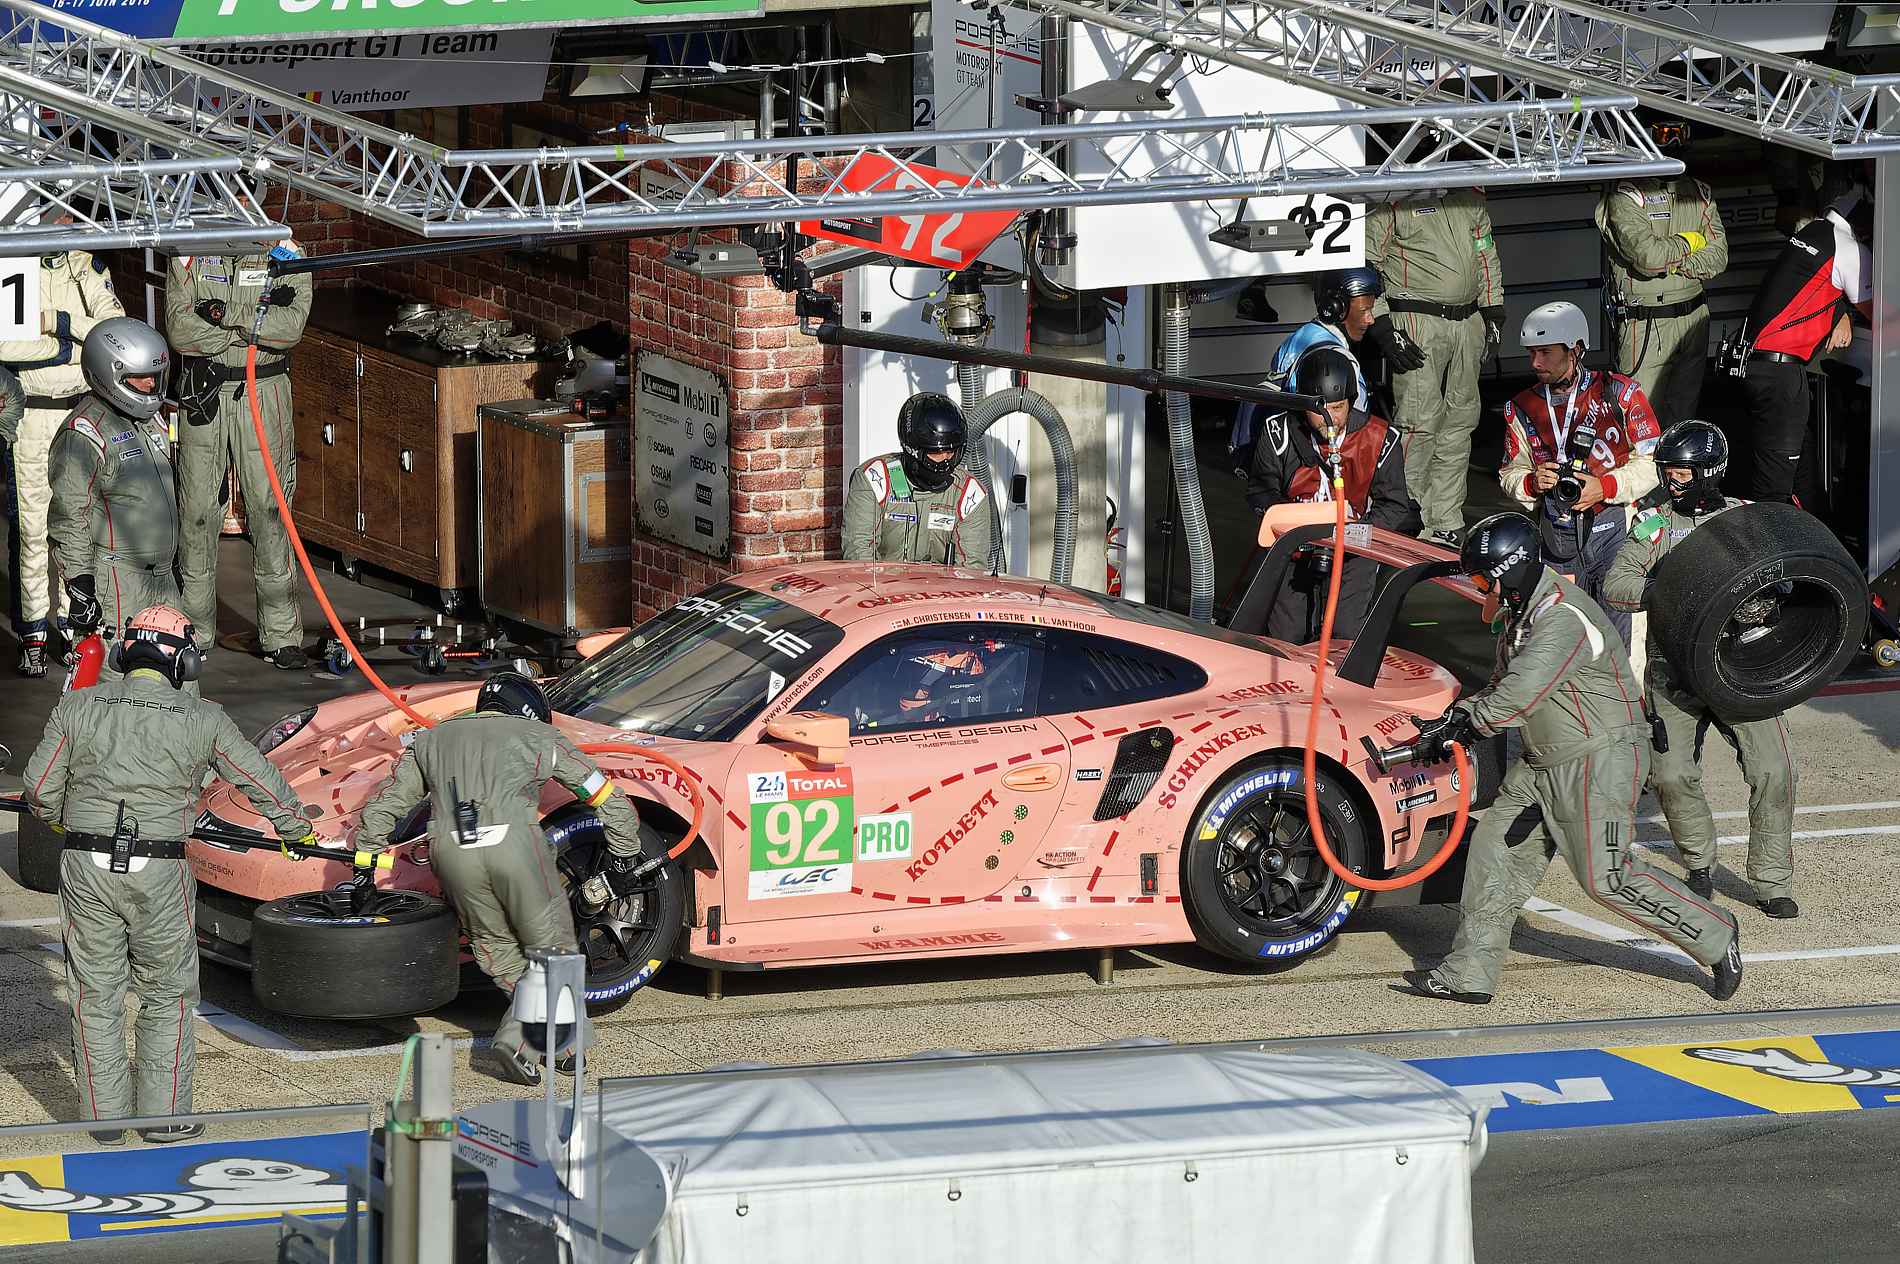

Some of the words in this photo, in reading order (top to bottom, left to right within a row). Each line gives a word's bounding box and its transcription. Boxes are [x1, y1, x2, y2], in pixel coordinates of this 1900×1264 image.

[956, 51, 1003, 76] MOTORSPRT
[331, 88, 411, 105] Vanthoor
[683, 386, 710, 415] Mobil
[650, 464, 672, 483] OSRAM
[689, 455, 717, 476] RECARO
[1703, 462, 1728, 478] uve
[1489, 545, 1529, 579] uvex
[914, 611, 971, 624] CHRISTENSEN
[998, 612, 1025, 622] ESTRE
[1051, 618, 1097, 633] VANTHOOR
[93, 696, 186, 715] PORSCHE
[761, 665, 826, 726] www.porsche.com
[850, 731, 951, 748] PORSCHE
[958, 723, 1038, 737] DESIGN
[915, 738, 979, 749] TIMEPIECES
[1158, 722, 1268, 810] SCHINKEN
[790, 777, 848, 792] TOTAL
[1219, 771, 1292, 814] MICHELIN
[1389, 777, 1416, 796] Mobil
[553, 817, 604, 842] MICHEL
[765, 799, 840, 866] 92
[861, 819, 910, 855] PRO
[904, 788, 1000, 883] KOTLETT
[1606, 820, 1703, 942] PORSCHE
[1267, 916, 1340, 956] MICHELIN
